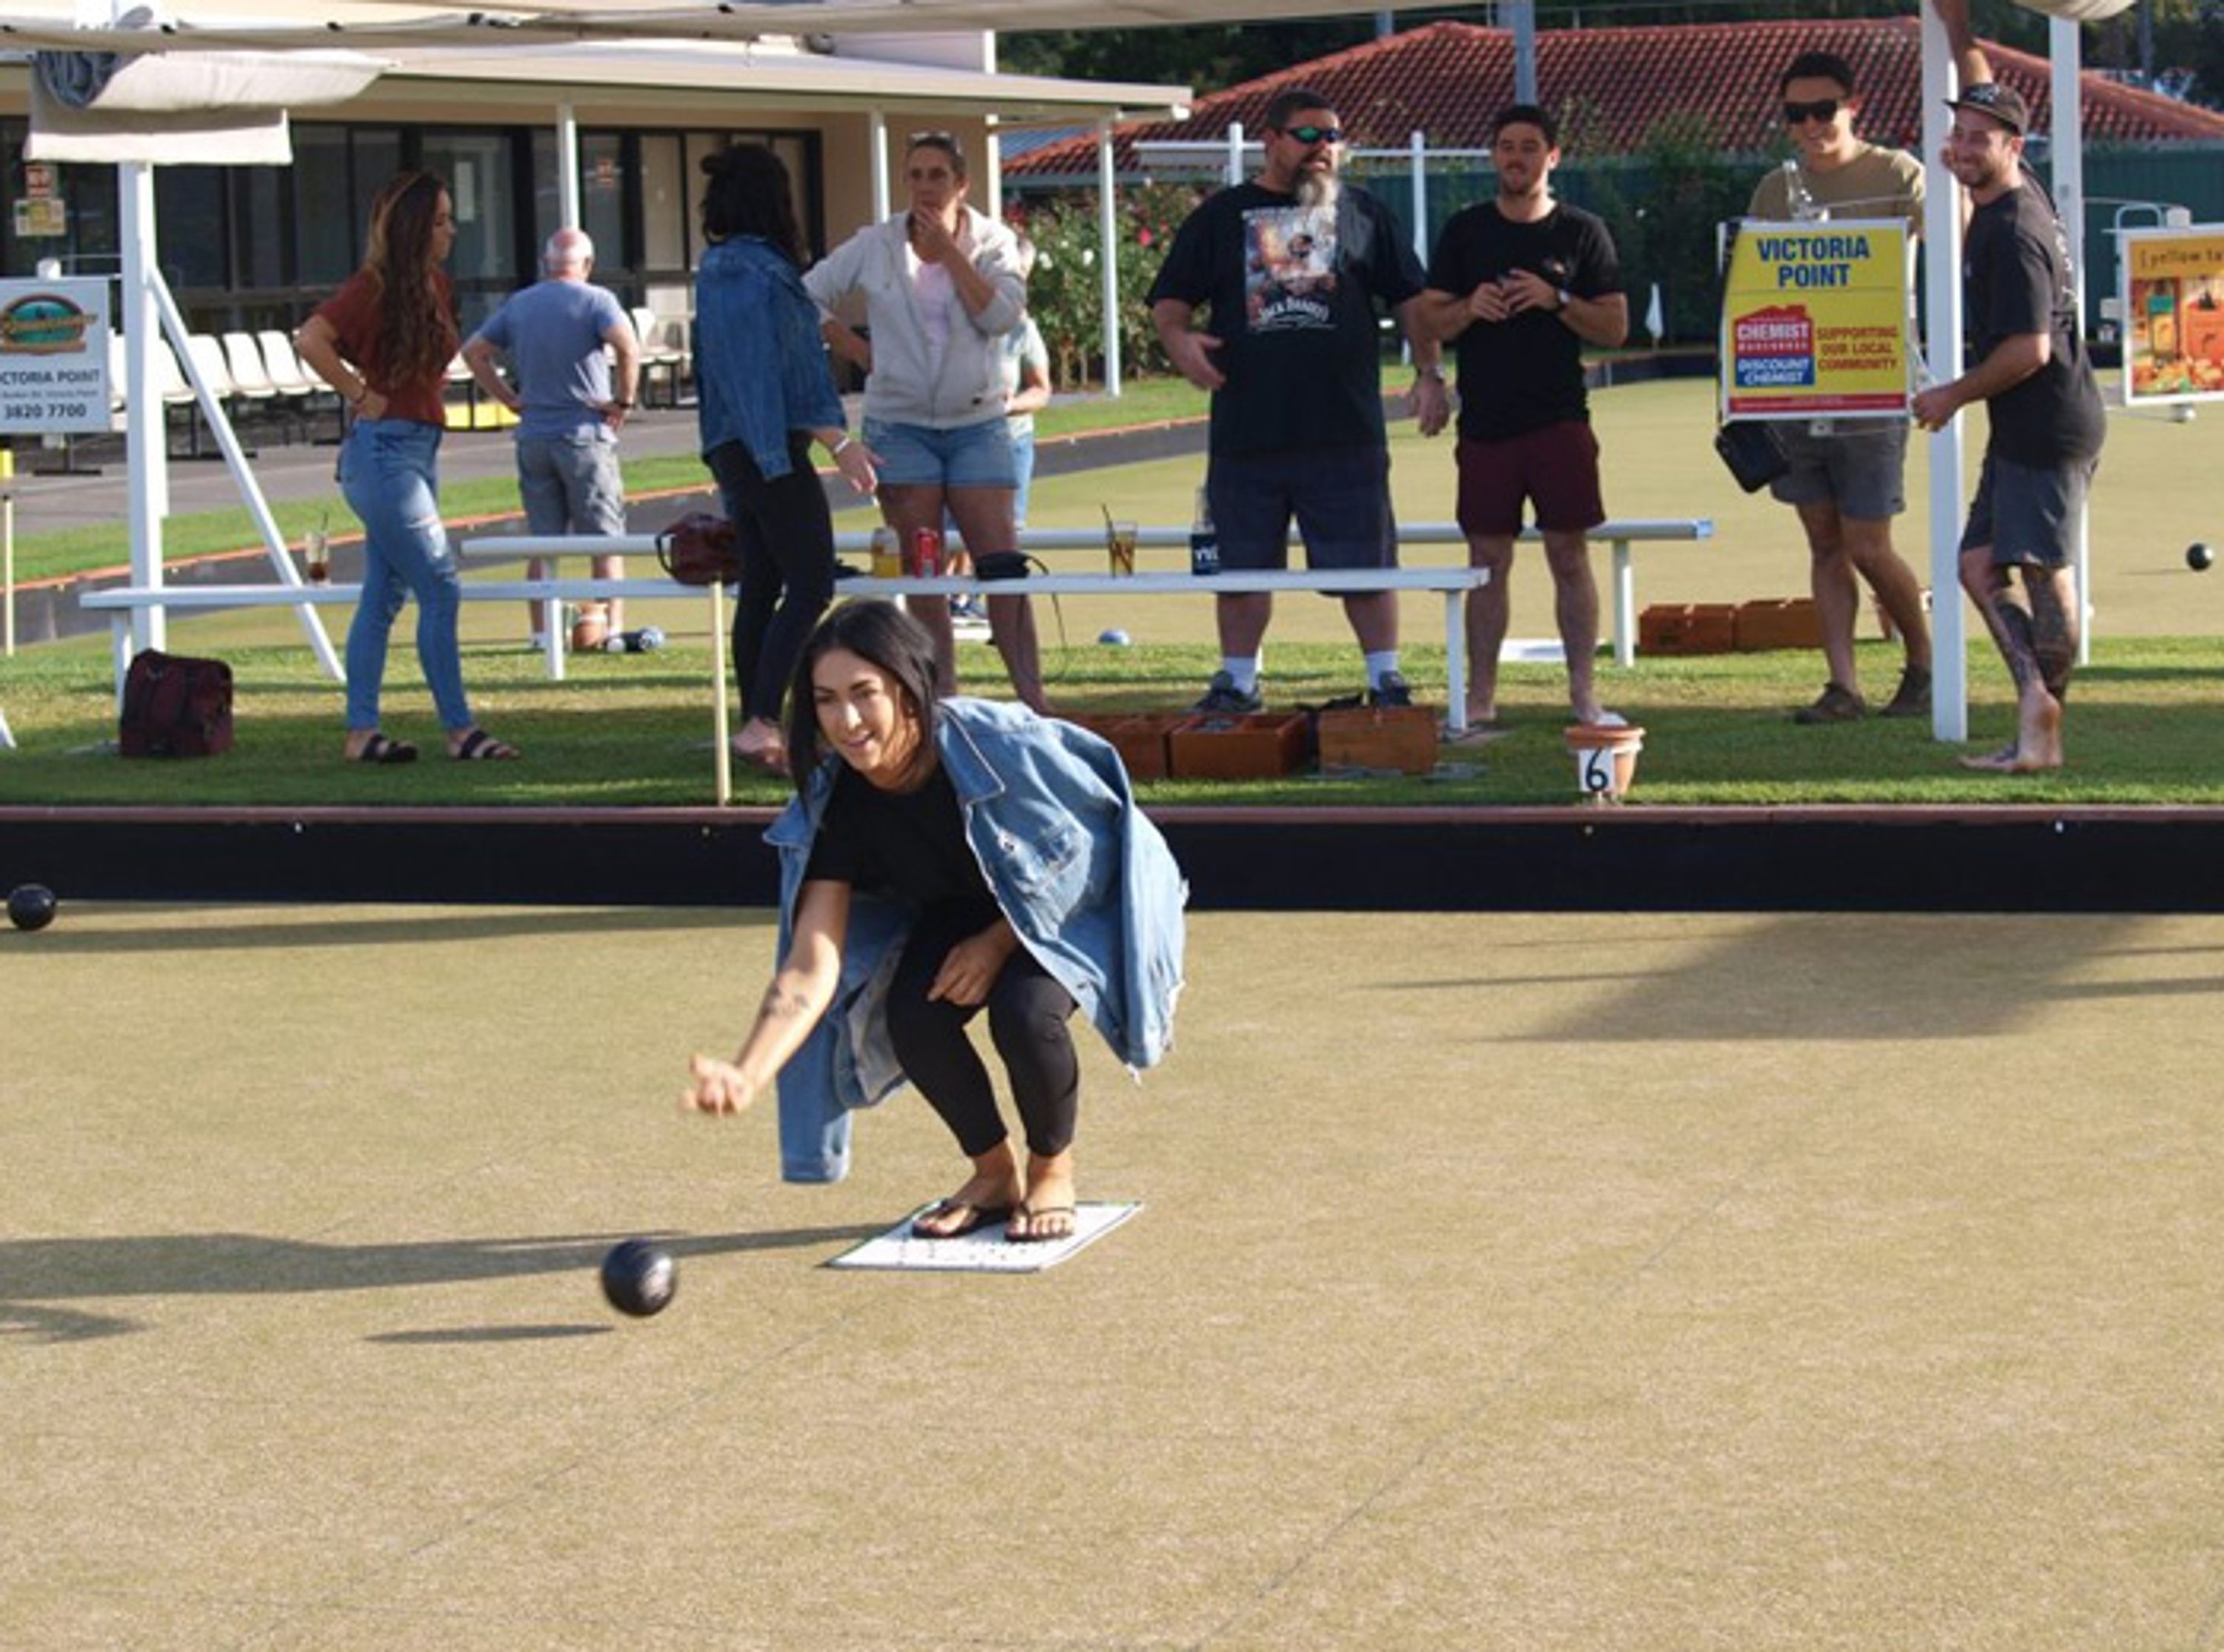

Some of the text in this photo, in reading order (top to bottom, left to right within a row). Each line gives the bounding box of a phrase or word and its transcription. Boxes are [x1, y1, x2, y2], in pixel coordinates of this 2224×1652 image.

[1757, 236, 1870, 261] VICTORIA
[1778, 264, 1851, 288] POINT
[1738, 322, 1809, 341] CHEMIST
[1738, 358, 1809, 372] DISCOUNT
[58, 369, 99, 382] POINT
[1744, 371, 1804, 384] CHEMIST
[47, 402, 87, 418] 7700
[1585, 746, 1609, 792] 6
